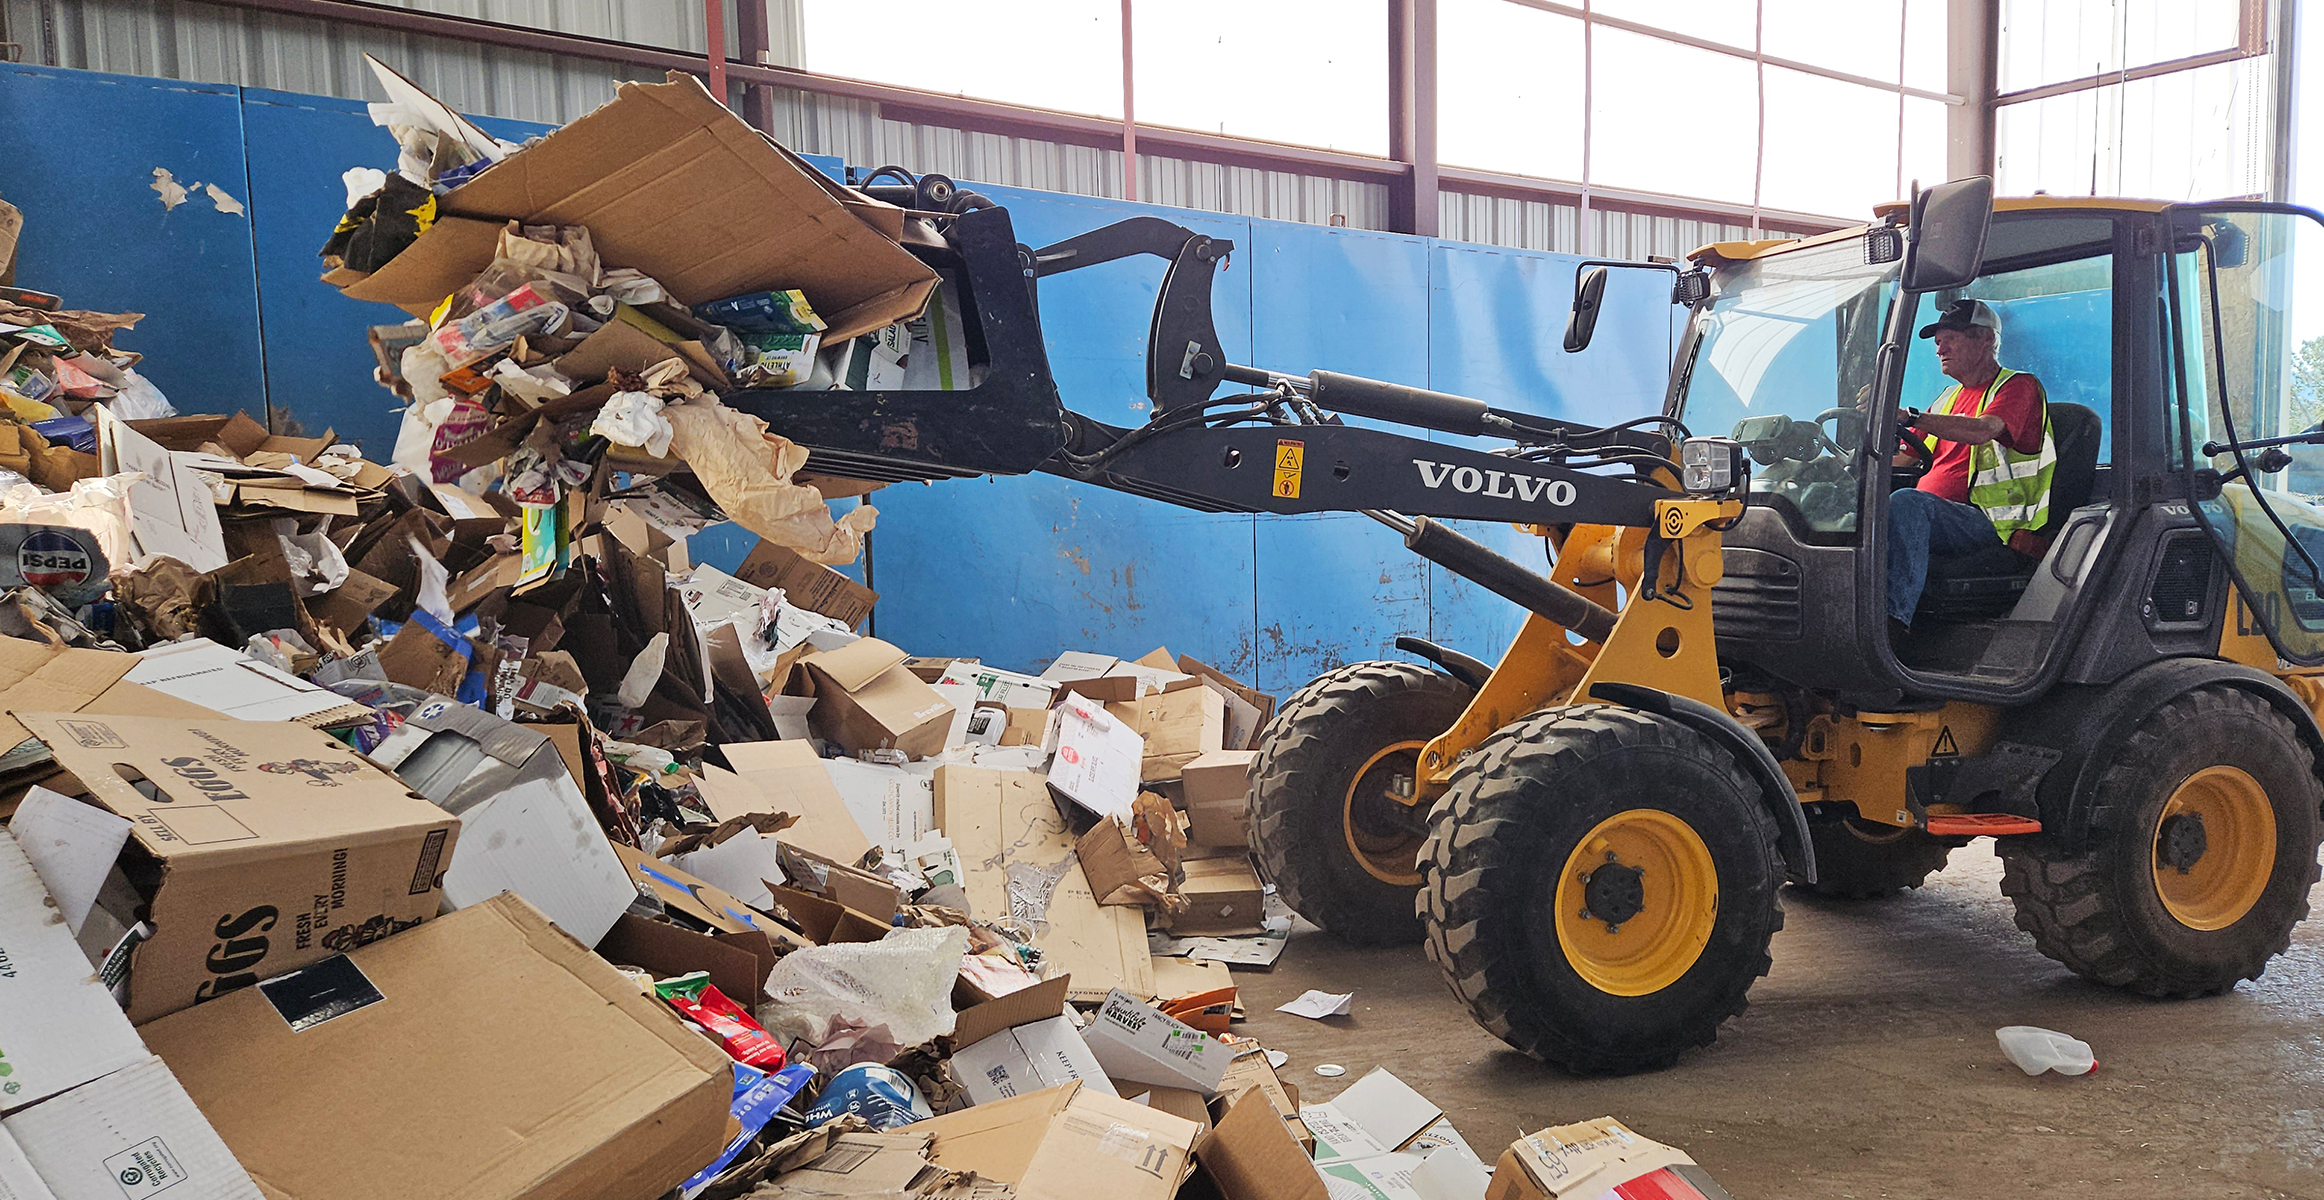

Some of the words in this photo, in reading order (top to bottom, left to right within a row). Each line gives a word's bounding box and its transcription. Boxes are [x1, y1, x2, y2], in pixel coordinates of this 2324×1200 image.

[1412, 458, 1577, 507] VOLVO
[2160, 503, 2224, 516] VOVO
[22, 553, 87, 570] PEPSI
[913, 702, 946, 720] Breville
[160, 756, 251, 802] EGGS
[134, 814, 158, 825] BY
[149, 825, 178, 842] SELL
[331, 848, 348, 910] MORNING!
[314, 894, 330, 930] EVERY
[296, 912, 313, 950] FRESH
[194, 904, 280, 1004] GGS
[1104, 1008, 1142, 1032] HARVEST
[1107, 999, 1147, 1026] Bountiful
[1056, 1050, 1072, 1069] KEEP
[1068, 1068, 1080, 1080] FR
[130, 1152, 162, 1187] Corrugated
[144, 1150, 168, 1180] Recycles
